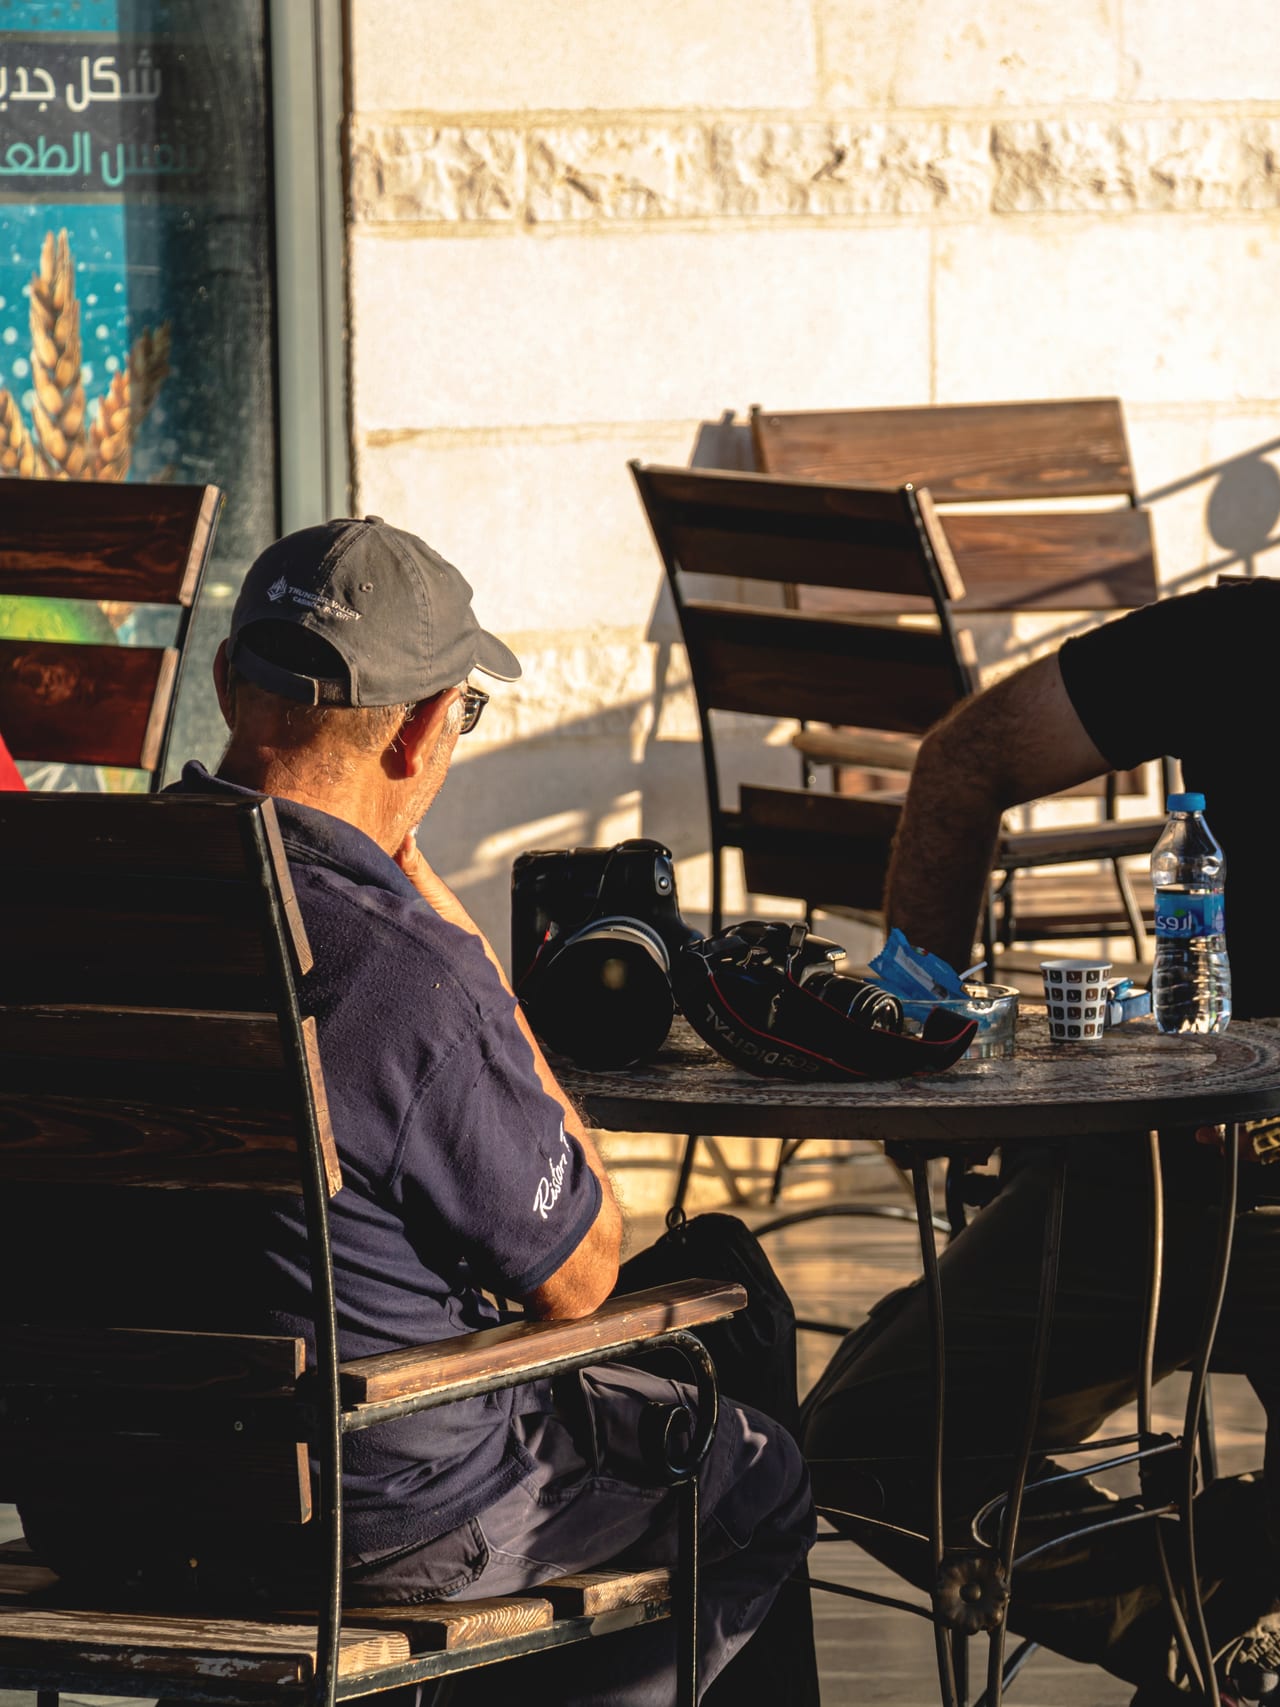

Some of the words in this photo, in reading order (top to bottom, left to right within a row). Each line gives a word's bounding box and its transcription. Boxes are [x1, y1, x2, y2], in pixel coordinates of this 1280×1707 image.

[66, 49, 162, 112] شكل
[0, 131, 91, 176] الطع
[288, 586, 329, 605] THUNDER
[331, 600, 361, 620] VALLEY
[705, 1003, 779, 1065] DIGITAL
